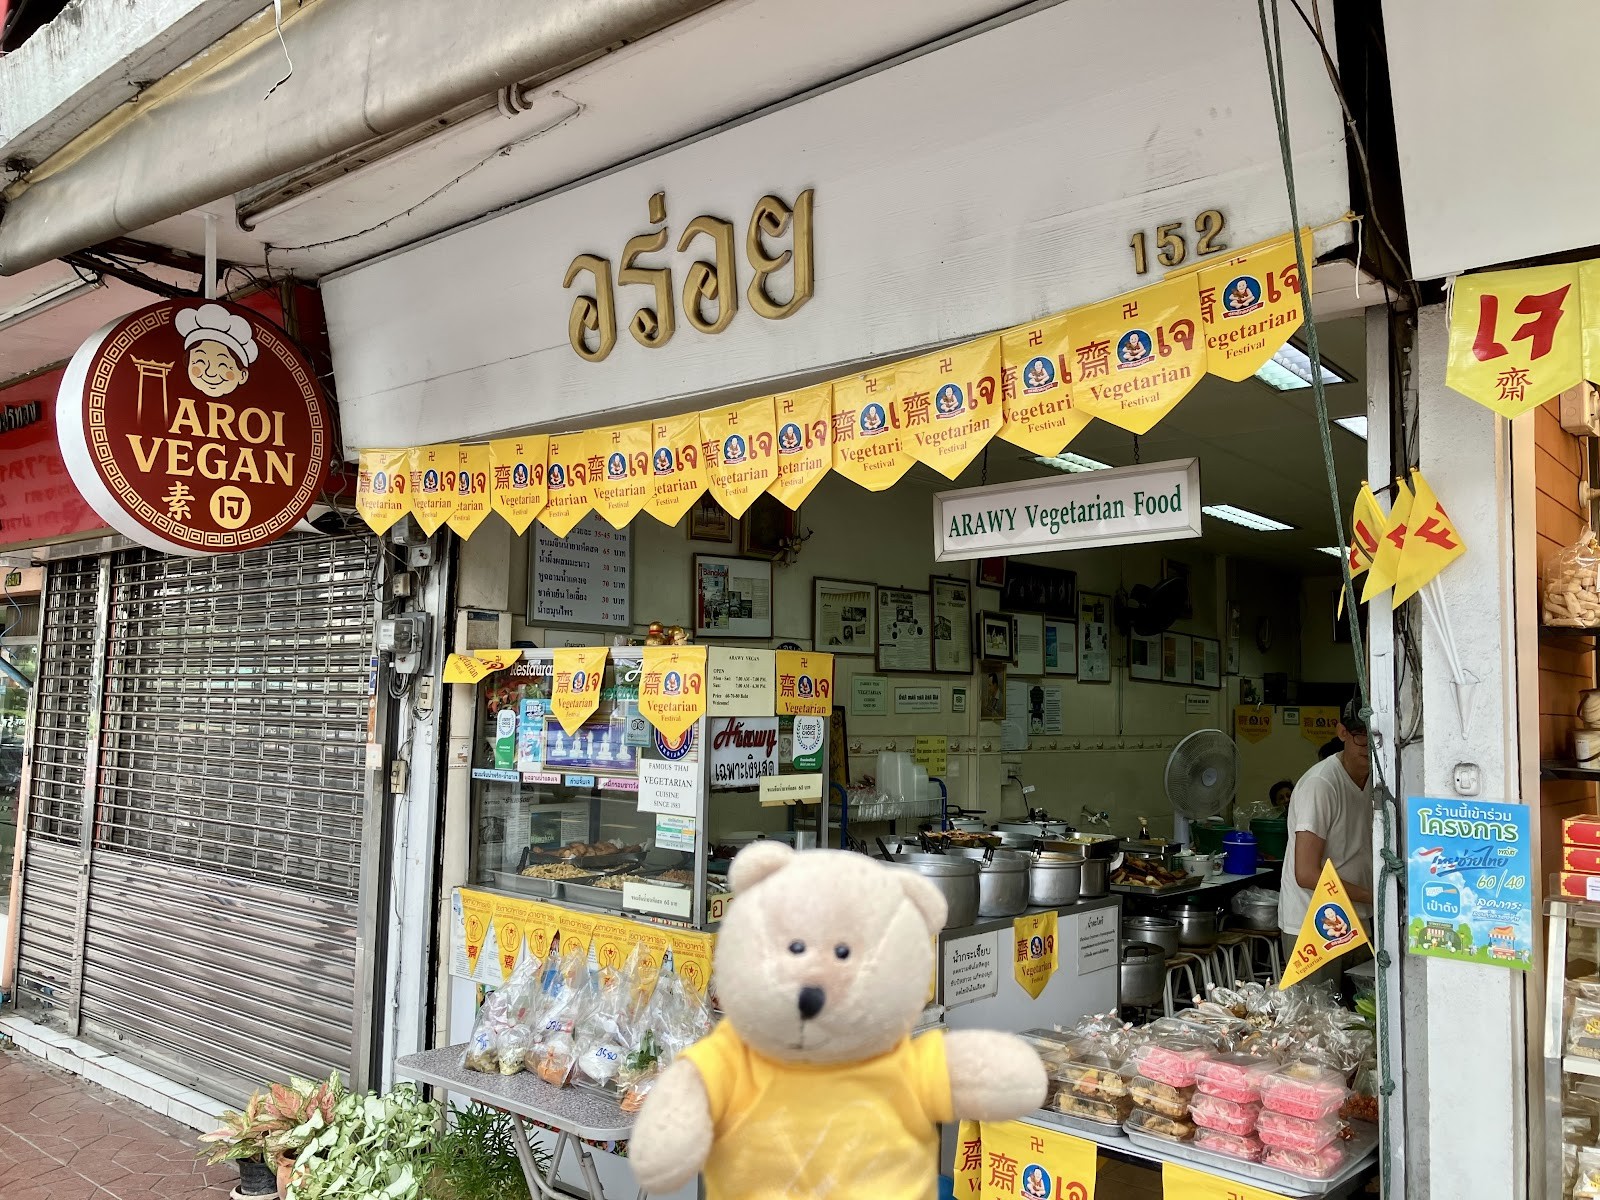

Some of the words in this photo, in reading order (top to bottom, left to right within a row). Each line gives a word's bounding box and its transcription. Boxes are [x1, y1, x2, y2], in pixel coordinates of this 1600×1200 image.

[1129, 210, 1226, 274] 152
[562, 189, 814, 362] อร่อย
[1156, 318, 1195, 358] เจ
[1204, 308, 1298, 352] egetarian
[1225, 338, 1266, 360] Festival
[1090, 363, 1192, 401] Vegetarian
[1494, 366, 1533, 402] 齋
[967, 375, 996, 410] เจ
[1120, 391, 1160, 410] Festival
[1002, 392, 1074, 425] Vegetari
[168, 398, 286, 447] AROI
[914, 416, 990, 448] Vegetarian
[1028, 417, 1066, 434] Festival
[805, 420, 827, 449] เจ
[748, 431, 773, 460] เจ
[841, 438, 902, 463] Vegetari
[938, 441, 967, 456] Festival
[125, 434, 296, 486] VEGAN
[629, 451, 648, 476] เจ
[675, 444, 697, 471] เจ
[863, 458, 895, 472] Festival
[388, 474, 406, 494] เจ
[440, 471, 456, 492] เจ
[472, 472, 486, 494] เจ
[530, 463, 544, 486] เจ
[566, 463, 586, 487] เจ
[710, 467, 768, 490] Vegetarian
[780, 476, 804, 488] Festival
[161, 481, 196, 521] 素
[500, 493, 540, 508] Vegetarian
[594, 484, 646, 504] Vegetarian
[725, 486, 748, 497] Festival
[361, 497, 402, 510] Vegetarian
[413, 498, 451, 510] Vegetarian
[608, 500, 629, 510] Festival
[656, 497, 679, 506] Festival
[948, 507, 1017, 537] ARAWY
[1025, 494, 1124, 534] Vegetarian
[1133, 484, 1182, 516] Food
[614, 549, 626, 557] บาท
[614, 565, 626, 573] บาท
[613, 581, 626, 589] บาท
[613, 597, 625, 605] บาท
[612, 613, 625, 621] บาท
[510, 660, 553, 677] Restaura
[585, 672, 601, 692] เจ
[683, 672, 702, 695] เจ
[814, 677, 829, 699] เจ
[558, 698, 593, 710] Vegetarian
[647, 700, 697, 714] Vegetarian
[785, 702, 826, 715] Vegetarian
[661, 714, 682, 722] Festival
[648, 763, 672, 771] FAMOUS
[674, 764, 689, 772] THAI
[644, 776, 693, 788] VEGETARIAN
[653, 800, 670, 808] SINCE
[655, 790, 679, 799] CUISINE
[1435, 803, 1512, 821] ร้านนี้เข้าร่วม
[1418, 808, 1519, 842] โครงการ
[1476, 868, 1526, 898] 60/40
[1426, 899, 1458, 914] เป๋าตัง
[1043, 934, 1054, 953] เจ
[953, 944, 991, 963] น้ำกระเจี๊ยบ
[1297, 944, 1318, 963] เจ
[1021, 962, 1052, 977] Vegetarian
[1295, 957, 1324, 975] Vegetarian
[988, 1151, 1019, 1194] 齋
